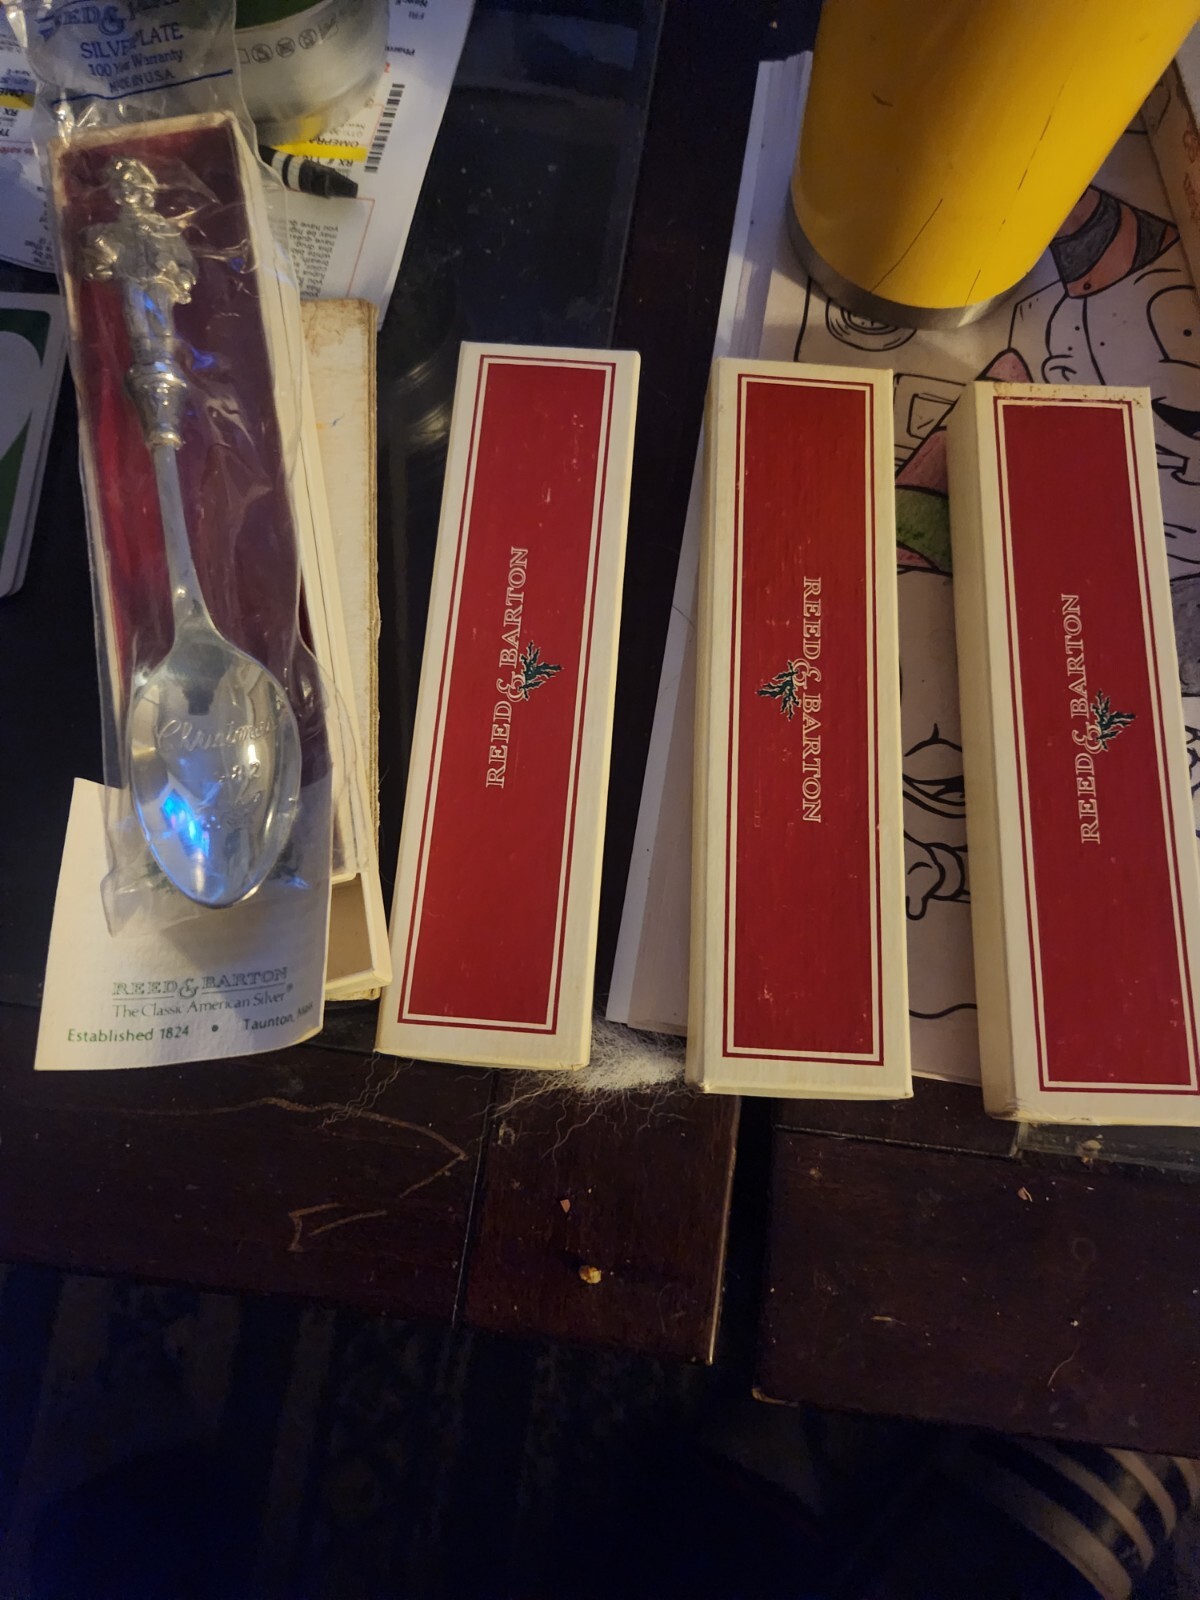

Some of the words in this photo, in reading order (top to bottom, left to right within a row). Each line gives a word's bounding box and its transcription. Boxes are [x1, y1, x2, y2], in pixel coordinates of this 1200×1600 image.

[88, 63, 112, 77] 100
[499, 546, 528, 669] BARTON
[803, 575, 822, 660] REED
[1061, 594, 1089, 719] BARTON
[496, 669, 526, 703] &
[792, 658, 822, 692] &
[486, 700, 512, 788] REED
[1072, 721, 1103, 755] &
[802, 692, 822, 823] BARTON
[1075, 752, 1100, 844] REED
[112, 981, 178, 996] REED
[178, 978, 199, 999] &
[201, 967, 287, 990] BARTON
[113, 1004, 138, 1018] The
[141, 1002, 183, 1018] Classic
[186, 998, 250, 1013] American
[68, 1028, 154, 1042] Established
[160, 1026, 190, 1039] 1824
